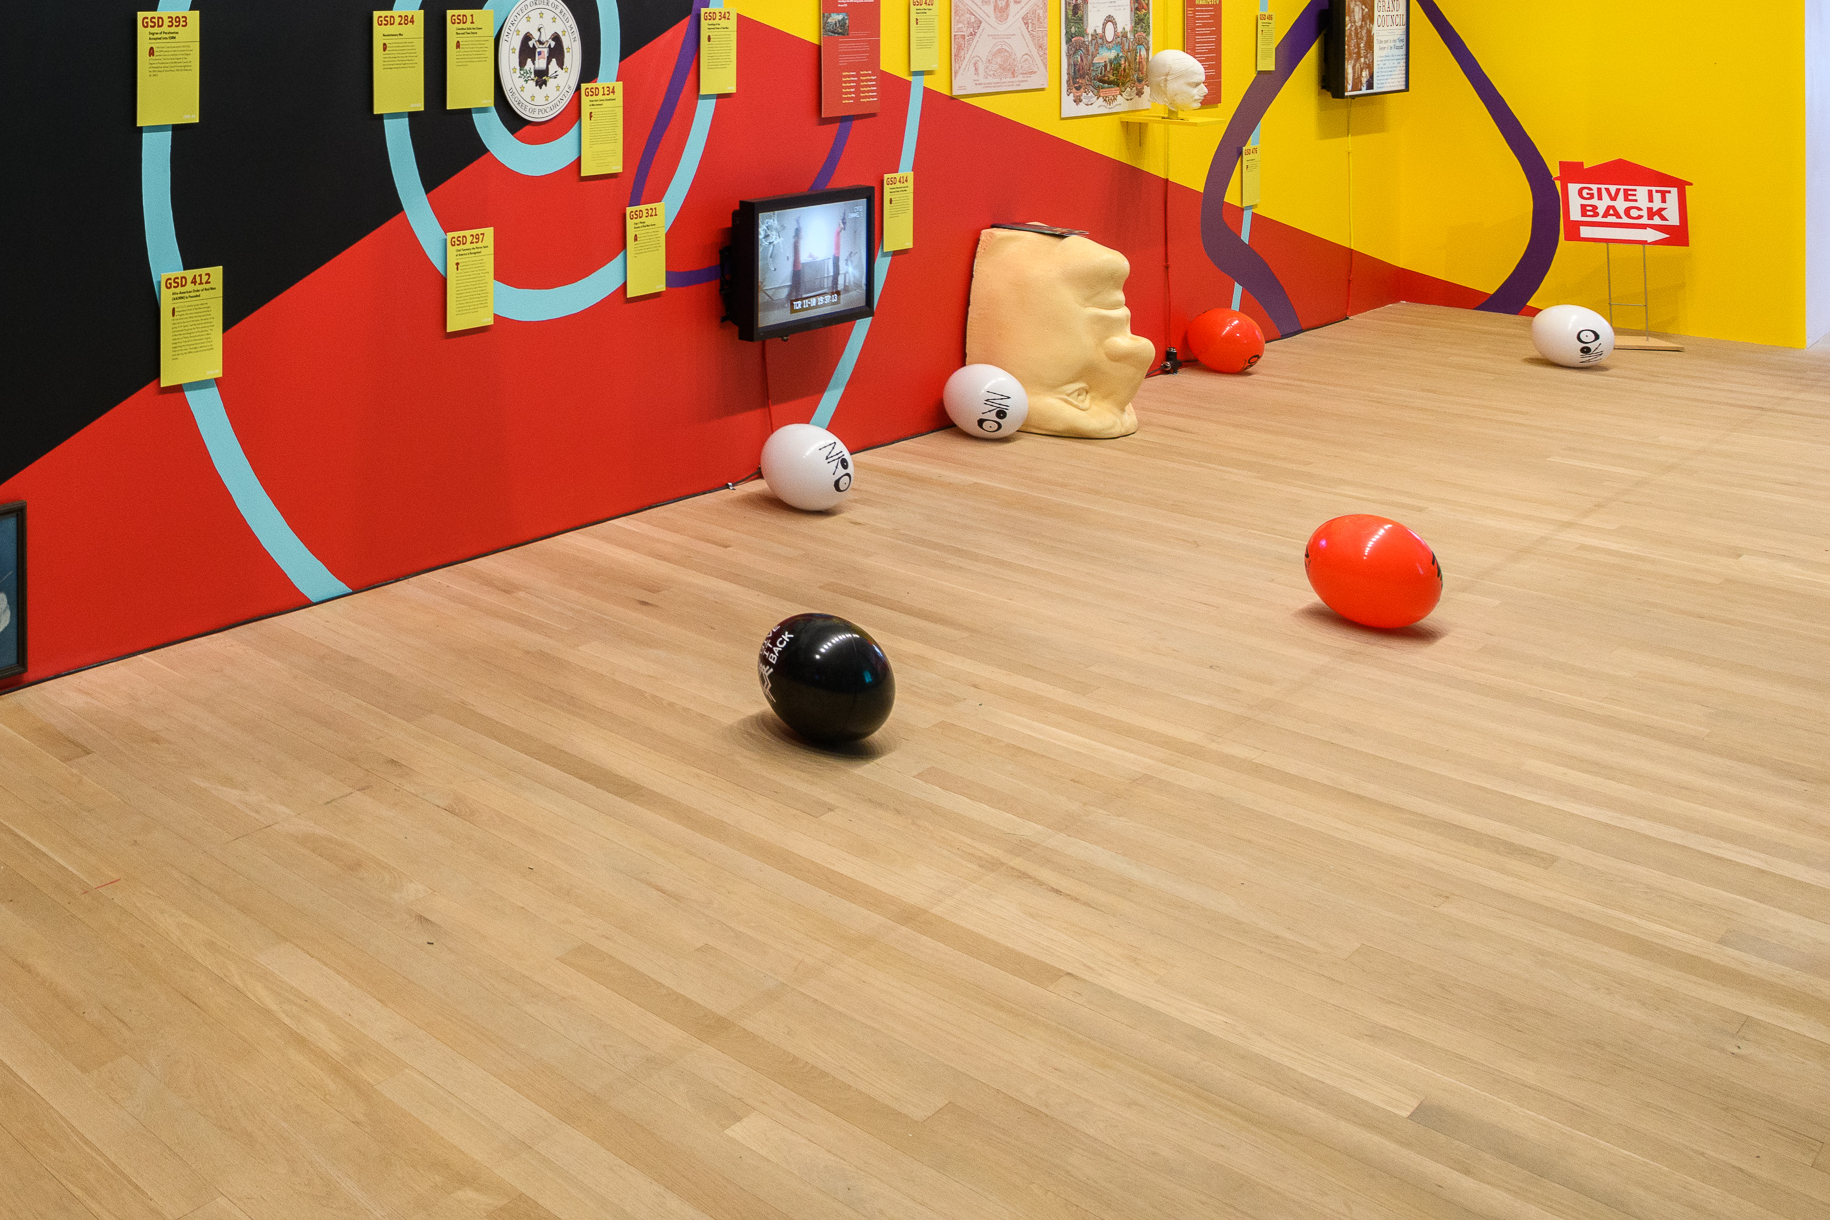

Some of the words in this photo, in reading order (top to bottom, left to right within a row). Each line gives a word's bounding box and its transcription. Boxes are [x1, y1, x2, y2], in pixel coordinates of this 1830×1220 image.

[1377, 0, 1400, 12] GRAND
[142, 16, 164, 28] GSD
[168, 16, 187, 28] 393
[377, 16, 395, 26] GSD
[398, 15, 414, 25] 284
[451, 14, 467, 24] GSD
[470, 14, 474, 24] 1
[505, 2, 528, 42] IMPROVED
[530, 0, 550, 7] ORDER
[551, 2, 558, 10] OF
[559, 6, 570, 23] RED
[704, 12, 716, 21] GSD
[718, 12, 730, 20] 342
[1377, 14, 1405, 27] COUNCIL
[585, 87, 599, 97] GSD
[602, 86, 615, 96] 134
[508, 87, 527, 112] DEGREE
[528, 107, 537, 115] OF
[538, 85, 572, 115] POCAHONTAS
[1578, 186, 1638, 202] GIVE
[1648, 189, 1671, 204] IT
[629, 210, 643, 220] GSD
[645, 207, 658, 218] 321
[1580, 204, 1669, 221] BACK
[450, 235, 467, 246] GSD
[470, 233, 484, 244] 297
[165, 276, 187, 289] GSD
[190, 273, 211, 286] 412
[768, 631, 794, 664] BACK
